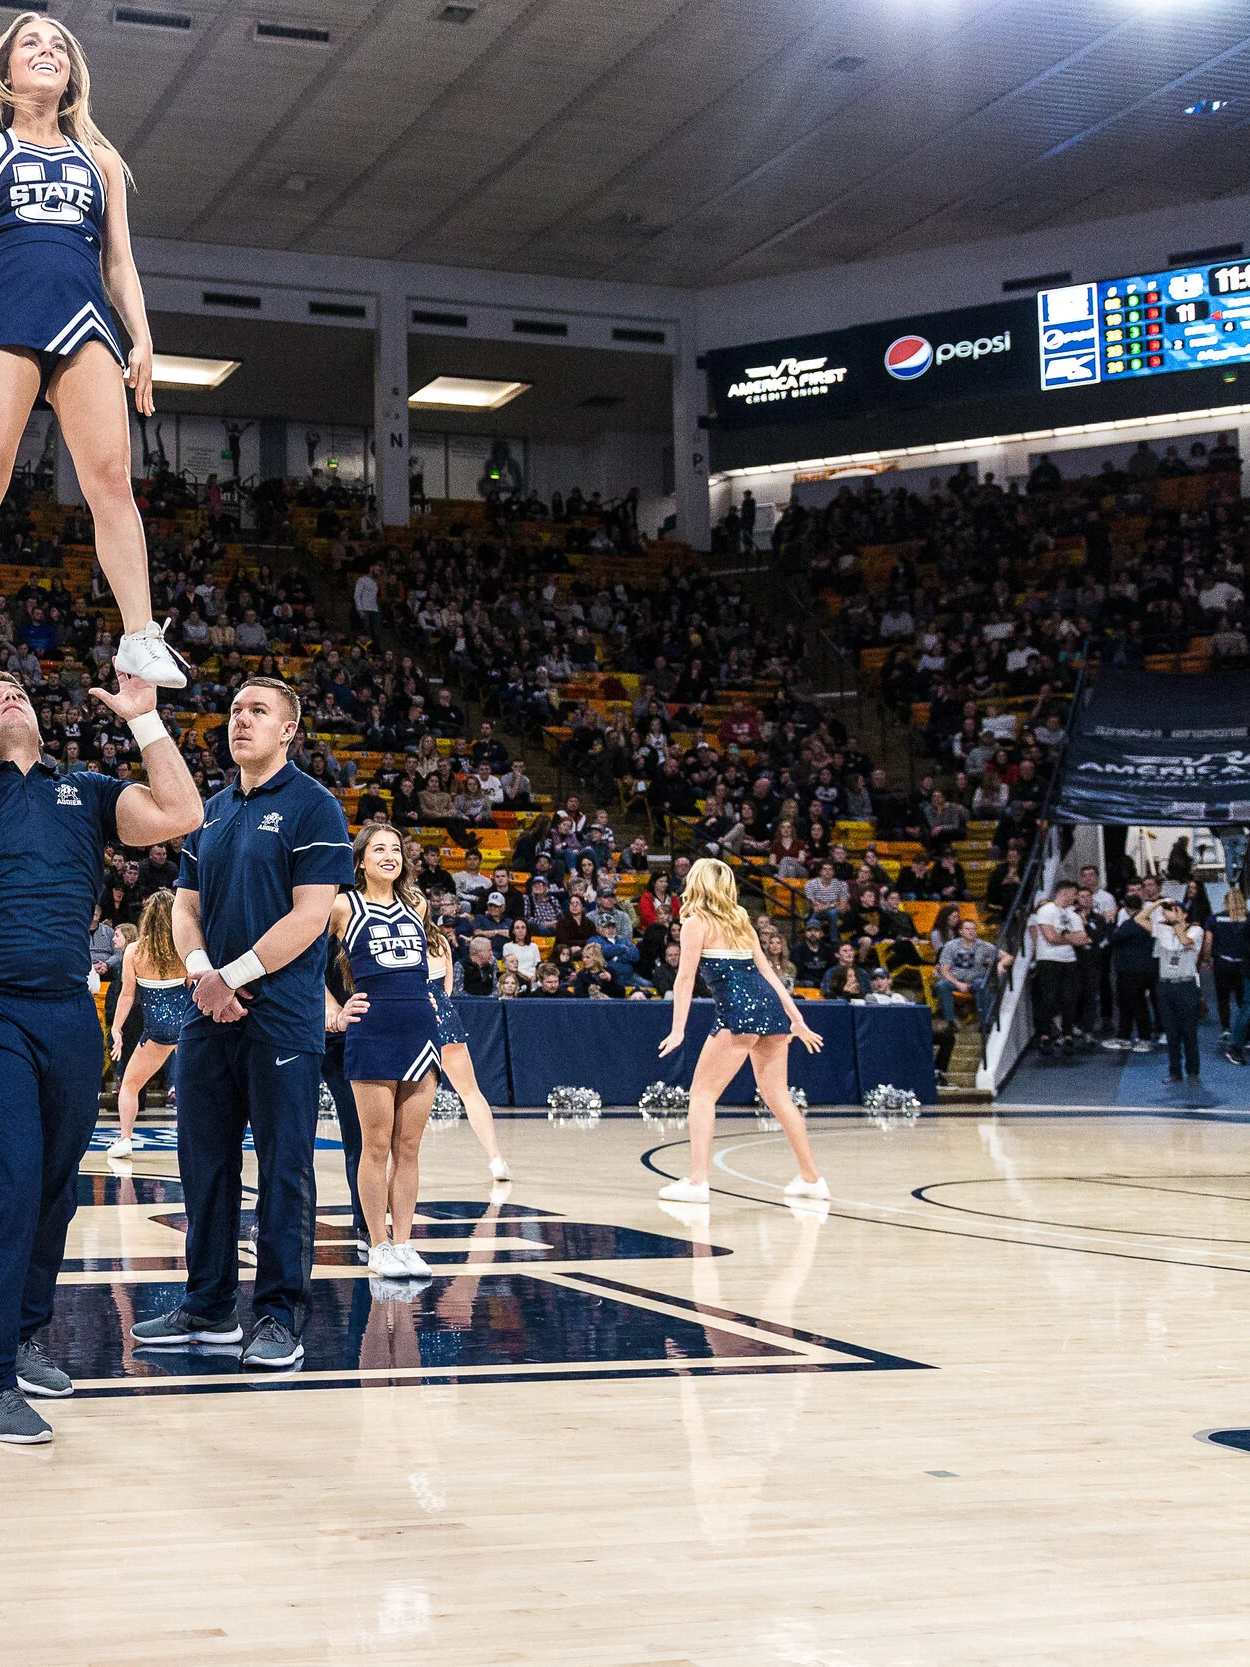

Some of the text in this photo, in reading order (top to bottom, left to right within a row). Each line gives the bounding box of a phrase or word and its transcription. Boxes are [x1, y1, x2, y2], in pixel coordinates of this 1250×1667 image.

[9, 182, 94, 212] STATE
[935, 330, 1011, 366] pepsi
[727, 367, 848, 397] AMERICA FIRST
[745, 385, 829, 404] CREDIT UNION
[1077, 761, 1246, 776] AMERICA
[368, 936, 423, 955] STATE
